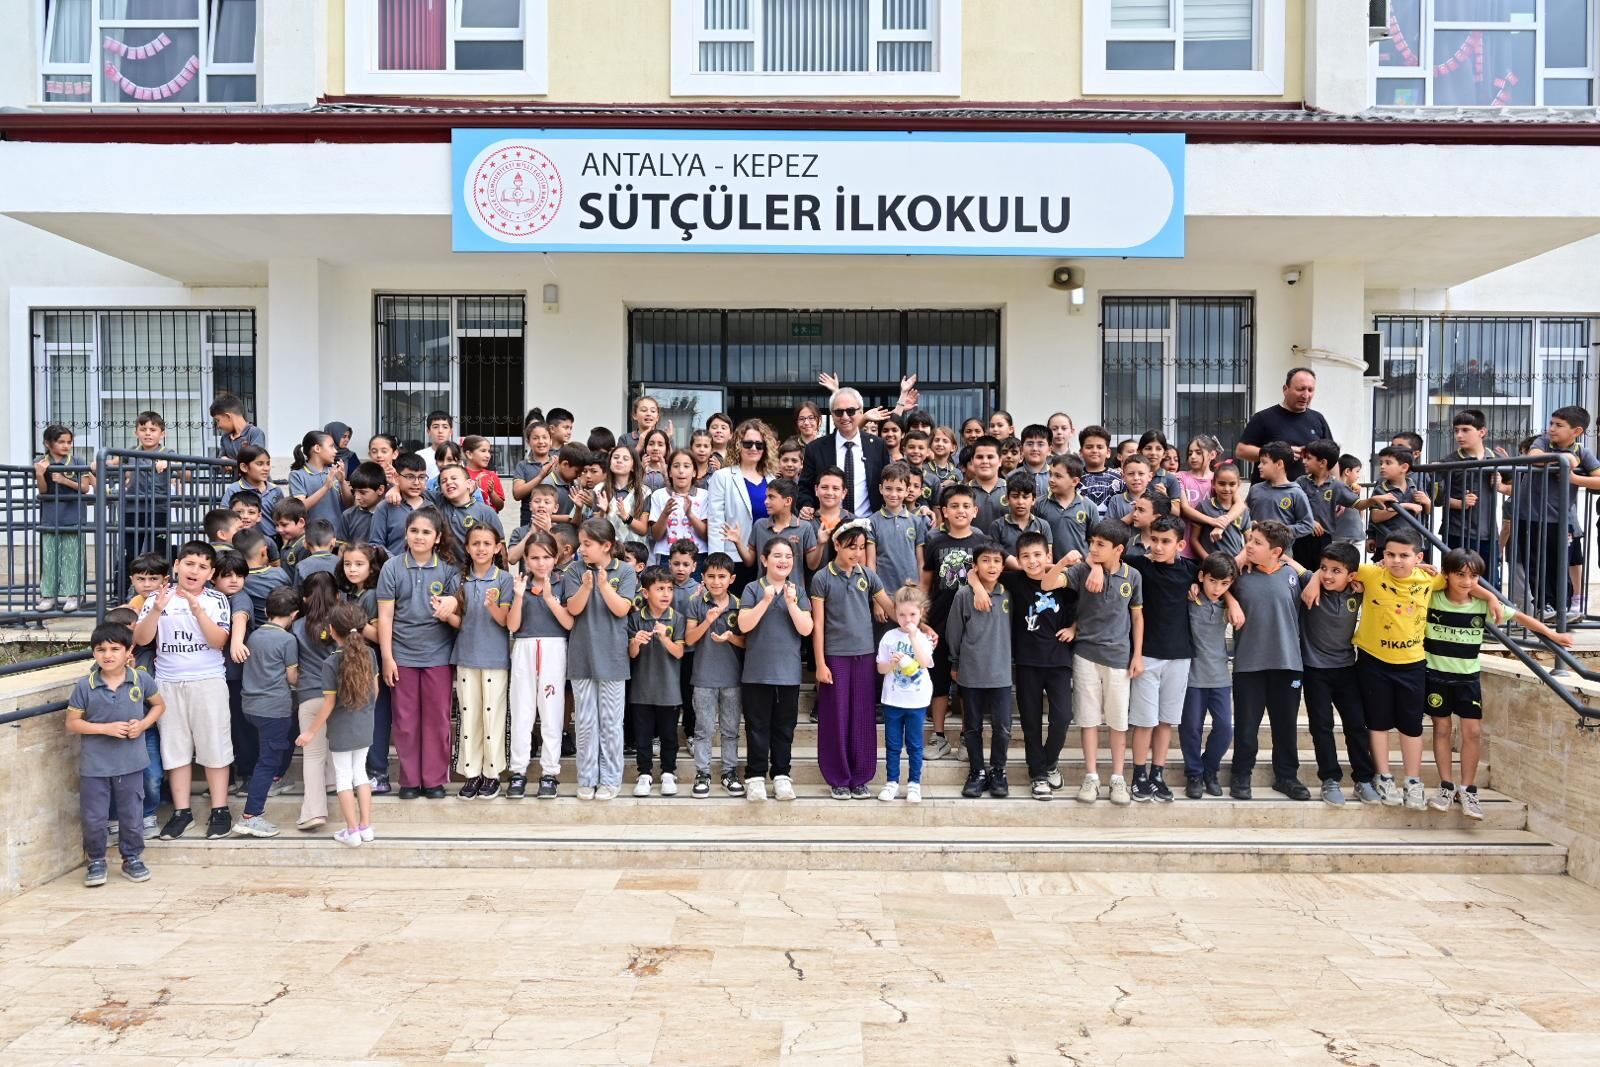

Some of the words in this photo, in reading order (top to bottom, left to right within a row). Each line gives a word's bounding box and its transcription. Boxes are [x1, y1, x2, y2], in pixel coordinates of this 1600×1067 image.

[582, 152, 706, 177] ANTALYA
[734, 153, 819, 178] KEPEZ
[578, 183, 822, 242] SÜTÇÜLER
[835, 185, 1071, 234] İLKOKULU
[174, 630, 193, 642] Fly
[1432, 625, 1481, 636] ETIHAD
[161, 642, 210, 653] Emirates
